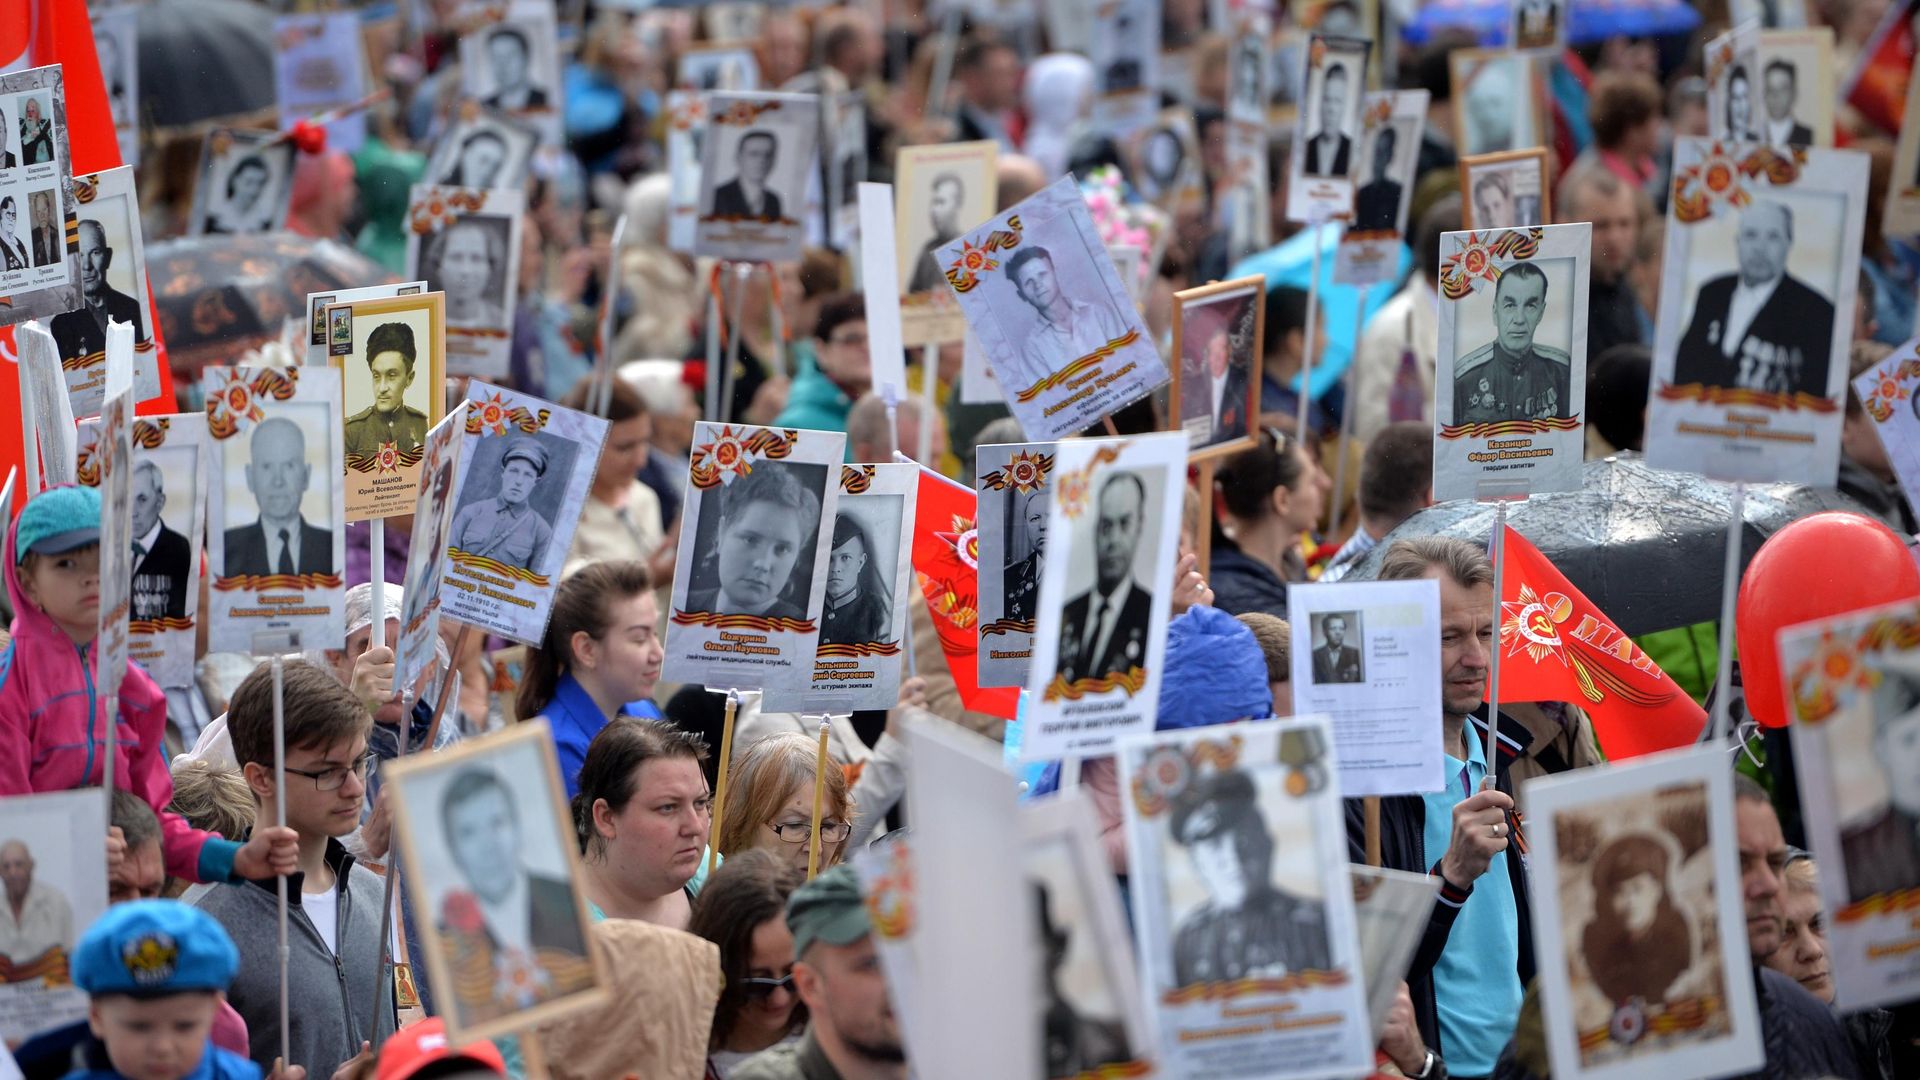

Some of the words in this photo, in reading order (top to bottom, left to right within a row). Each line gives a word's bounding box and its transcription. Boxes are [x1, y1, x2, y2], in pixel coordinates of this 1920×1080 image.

[1043, 384, 1096, 418] Александр
[1052, 416, 1080, 434] награда
[1488, 439, 1532, 450] Казанцев
[1498, 448, 1553, 460] Васильевич
[1483, 464, 1509, 472] гвардии
[1510, 462, 1535, 470] капитан
[372, 476, 403, 485] МАШАНОВ
[358, 487, 375, 496] Юрий
[376, 483, 417, 492] Всеволодович
[454, 601, 481, 613] ветеран
[481, 609, 499, 618] тыла
[720, 631, 767, 644] Кожурина
[704, 642, 733, 652] Ольга
[733, 643, 780, 656] Наумовна
[1569, 613, 1663, 680] МАЯ
[686, 653, 720, 663] лейтенант
[721, 655, 765, 665] медицинской
[765, 658, 792, 667] службы
[829, 670, 875, 681] Сергеевич
[821, 683, 848, 691] штурман
